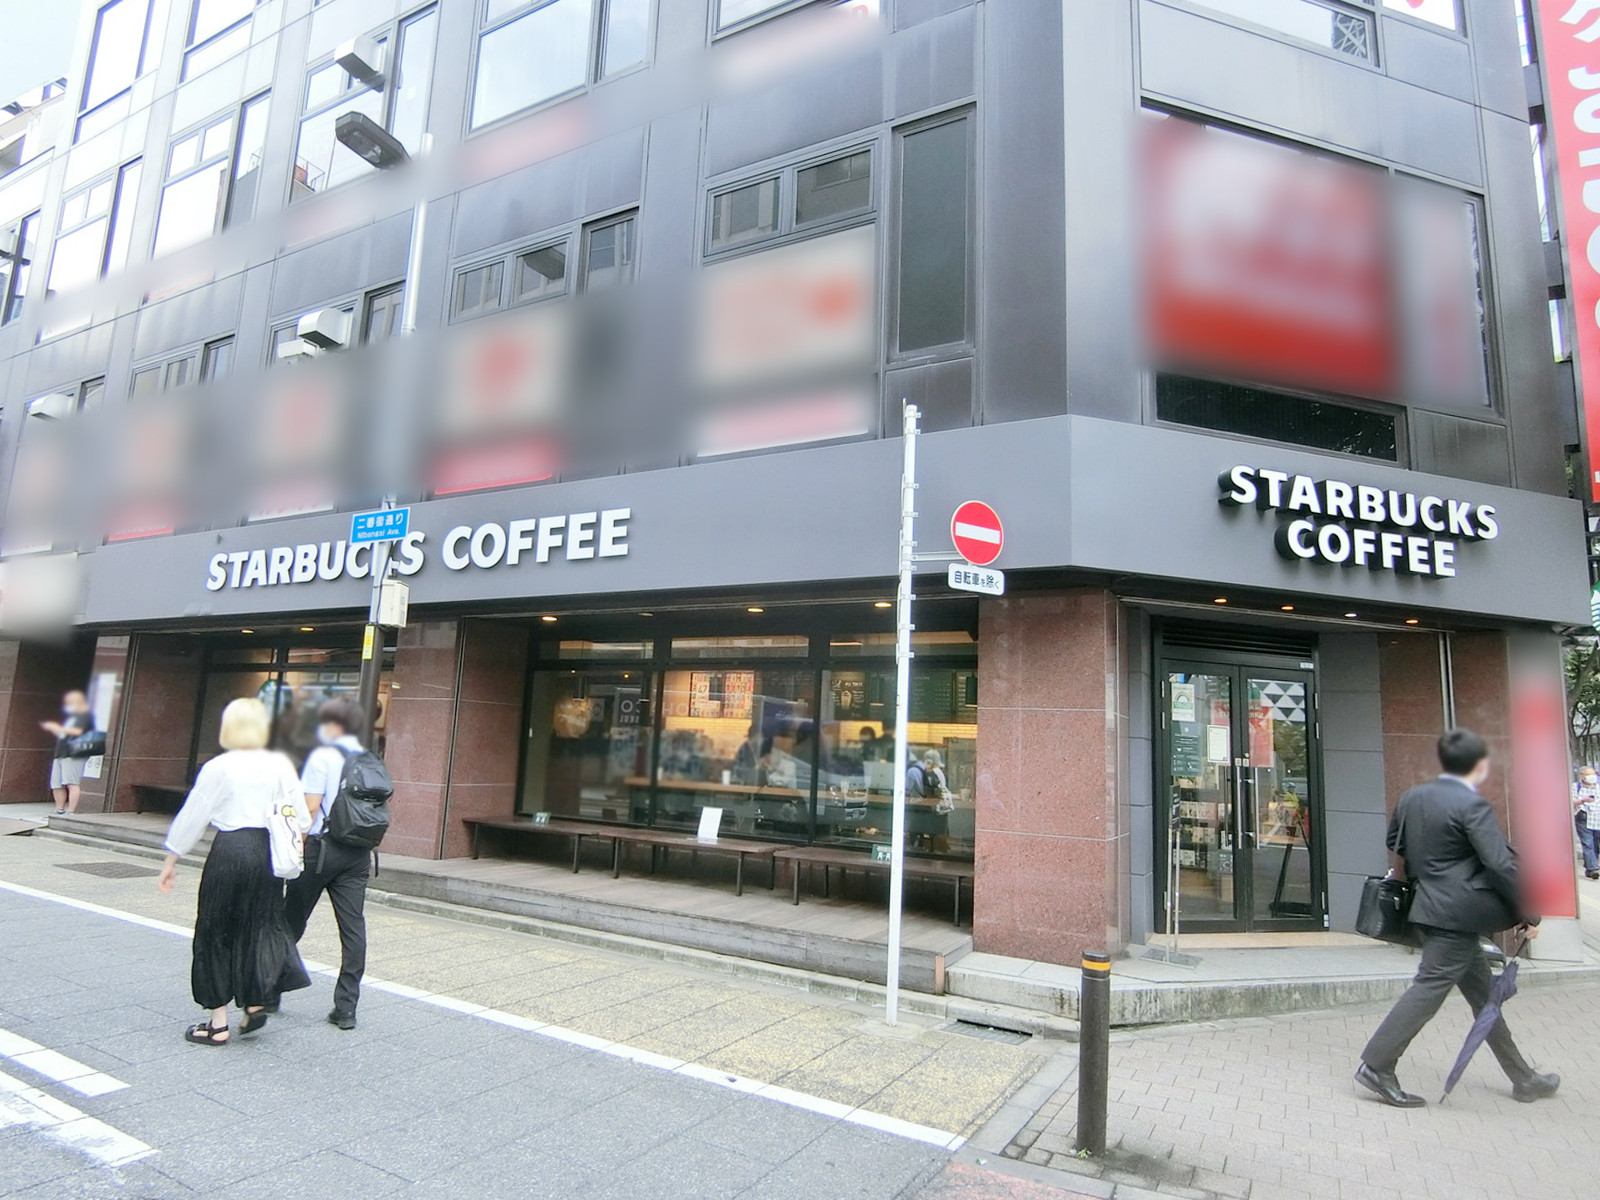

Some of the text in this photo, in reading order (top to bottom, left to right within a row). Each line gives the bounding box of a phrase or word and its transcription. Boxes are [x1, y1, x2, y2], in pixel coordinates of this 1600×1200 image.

[357, 512, 403, 529] 二番街通り
[1229, 464, 1499, 540] STARBUCKS
[441, 507, 631, 571] COFFEE
[1286, 519, 1457, 577] COFFEE
[954, 570, 999, 590] 自転車を除く
